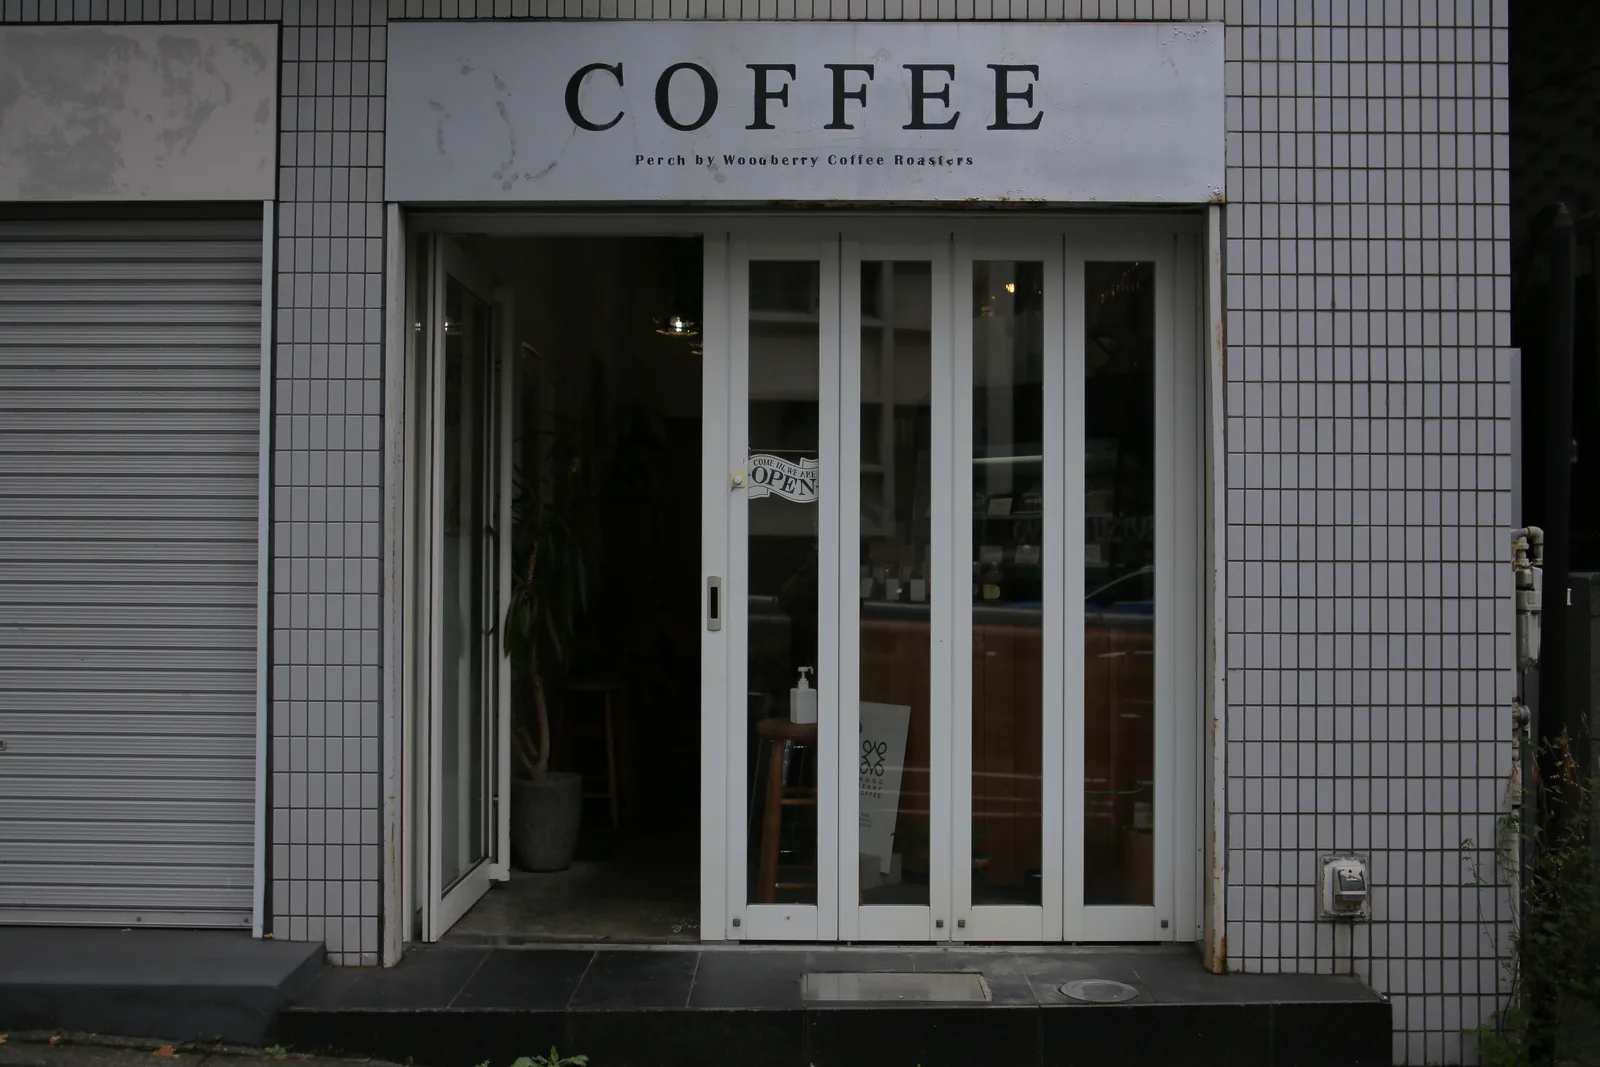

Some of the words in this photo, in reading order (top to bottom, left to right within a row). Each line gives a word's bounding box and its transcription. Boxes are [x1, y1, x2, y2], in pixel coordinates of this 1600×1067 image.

[564, 62, 1045, 132] COFFEE
[635, 154, 686, 166] Perch
[695, 154, 716, 168] by
[827, 154, 884, 166] Coffee
[894, 154, 973, 167] Roasters
[753, 458, 774, 466] COME
[787, 466, 798, 476] WE
[799, 470, 816, 478] ARE
[752, 466, 817, 495] OPEN
